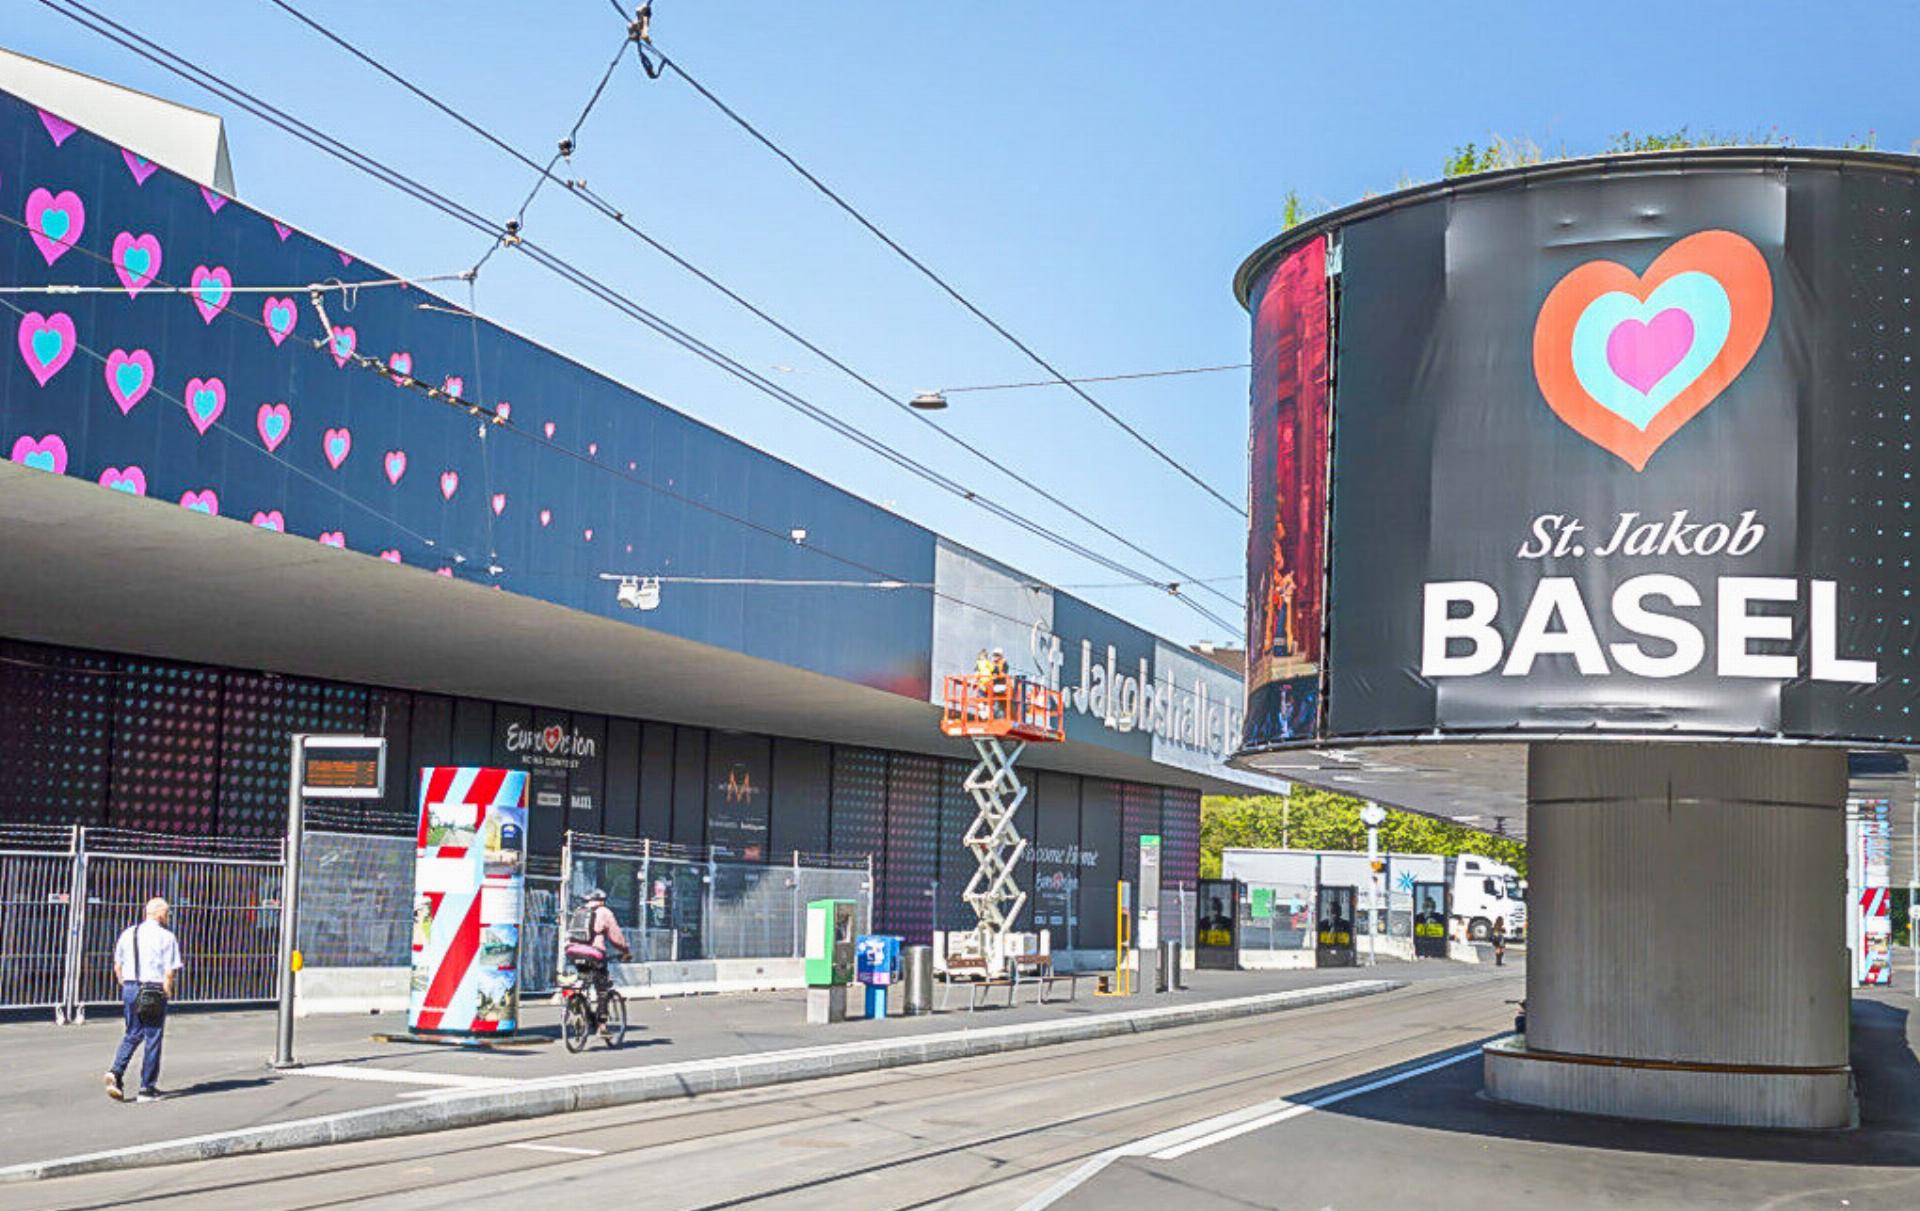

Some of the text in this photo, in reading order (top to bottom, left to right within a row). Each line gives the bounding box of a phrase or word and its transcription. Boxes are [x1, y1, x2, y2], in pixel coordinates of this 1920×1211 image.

[1517, 509, 1767, 558] St. Jakob
[1420, 573, 1878, 684] BASEL
